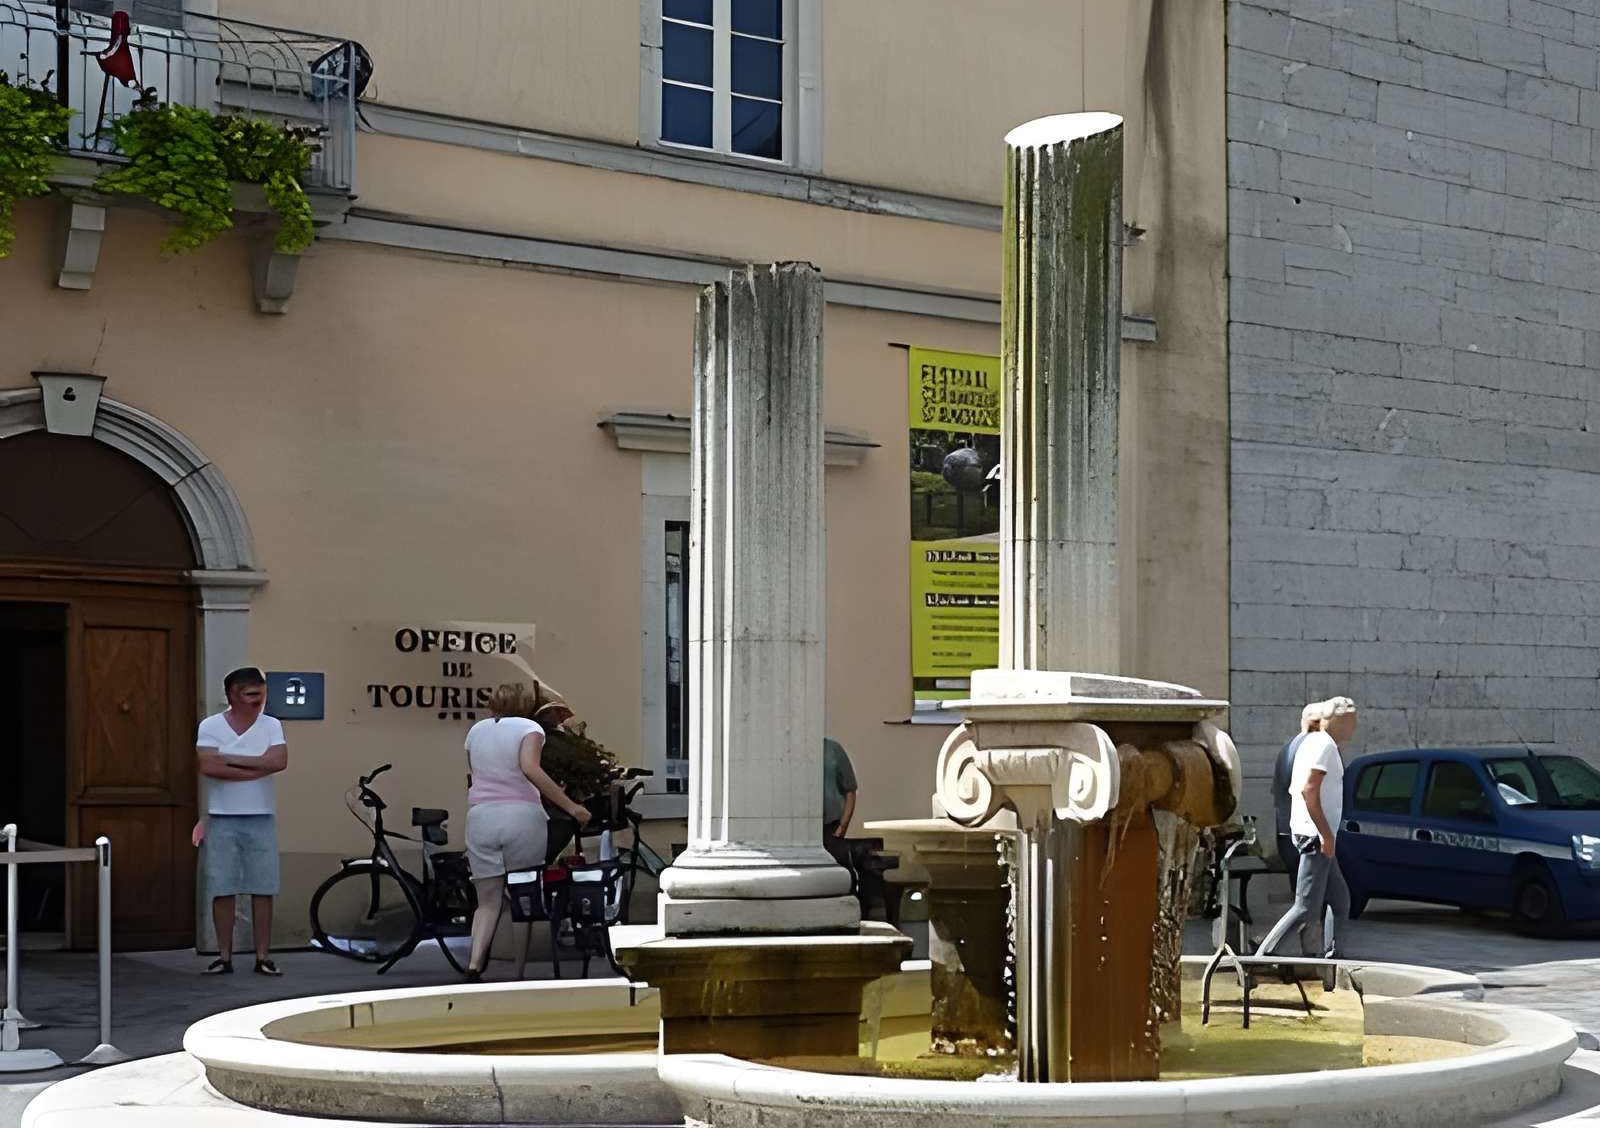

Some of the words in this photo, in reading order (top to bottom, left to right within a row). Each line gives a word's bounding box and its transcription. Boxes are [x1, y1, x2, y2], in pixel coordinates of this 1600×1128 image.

[395, 628, 516, 654] OFFICE
[442, 662, 472, 678] DE
[367, 684, 494, 709] TOURIS
